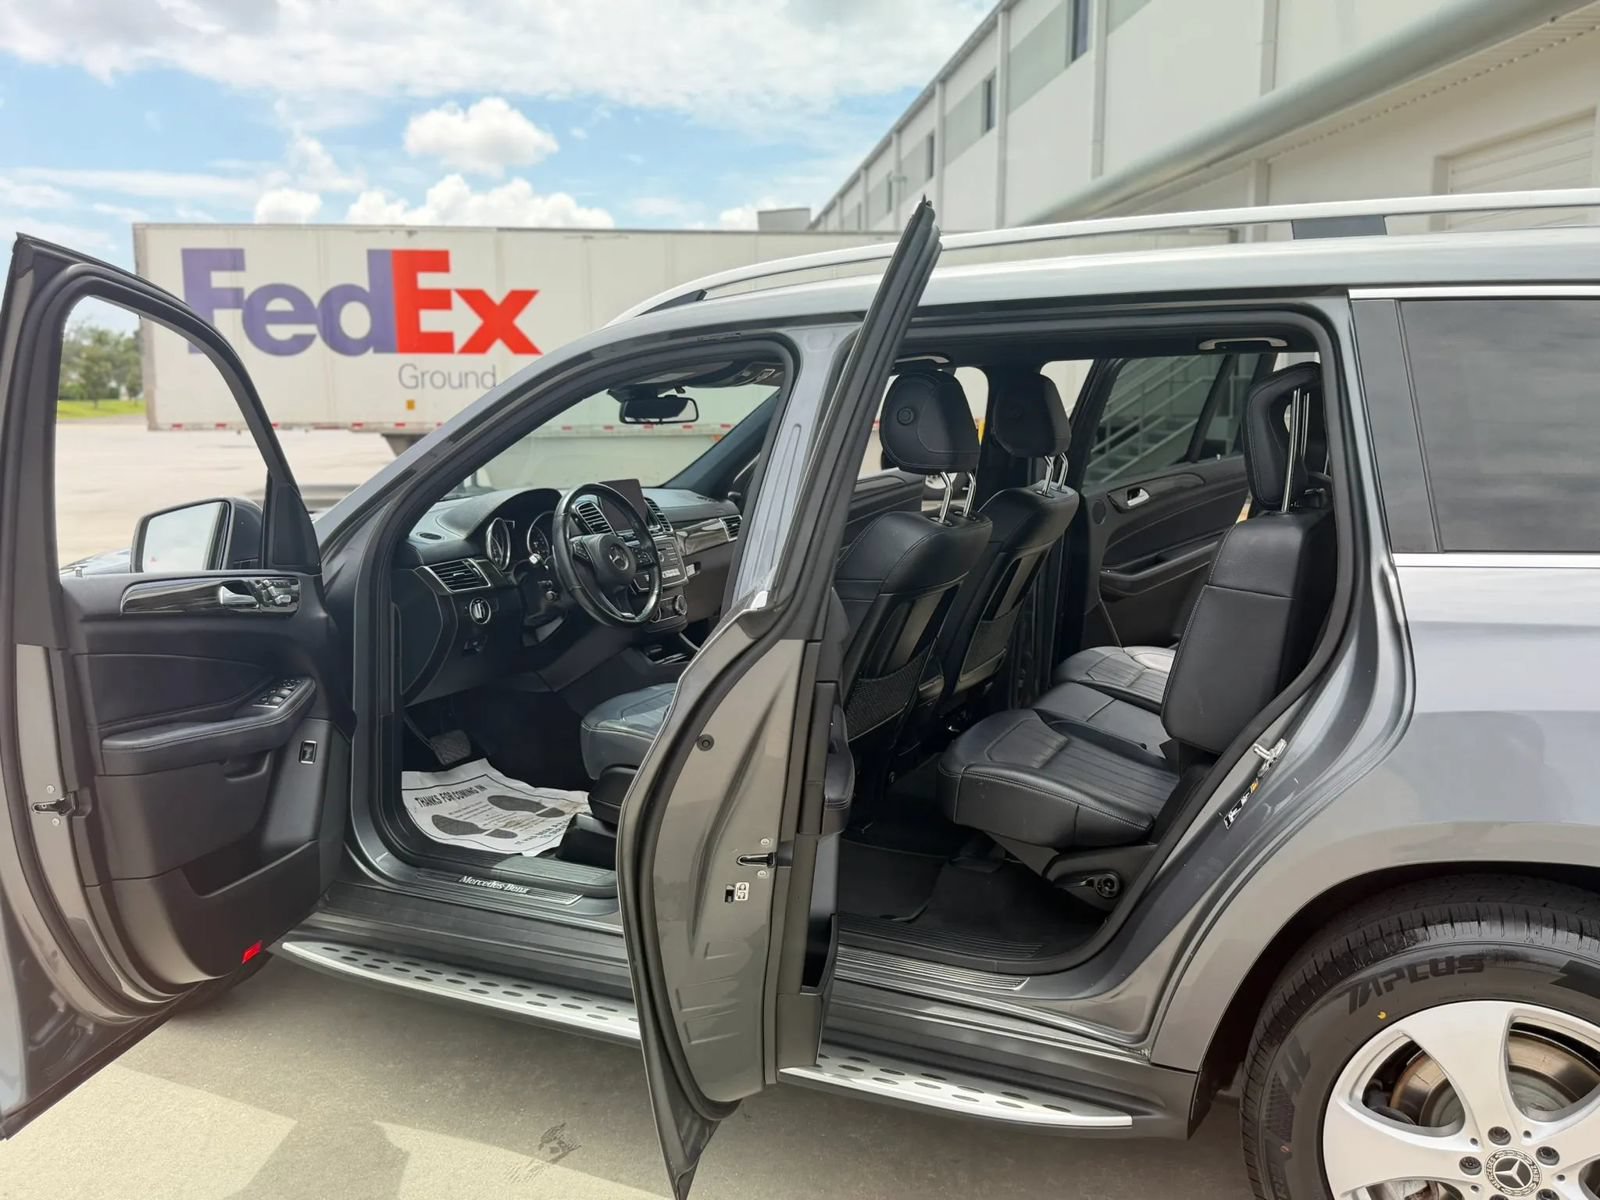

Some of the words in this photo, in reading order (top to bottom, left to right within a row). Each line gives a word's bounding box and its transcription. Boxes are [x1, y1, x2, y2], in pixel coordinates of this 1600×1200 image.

[181, 248, 543, 357] FedEx
[398, 363, 497, 390] Ground
[414, 795, 442, 808] THANKS
[439, 792, 455, 803] FOR
